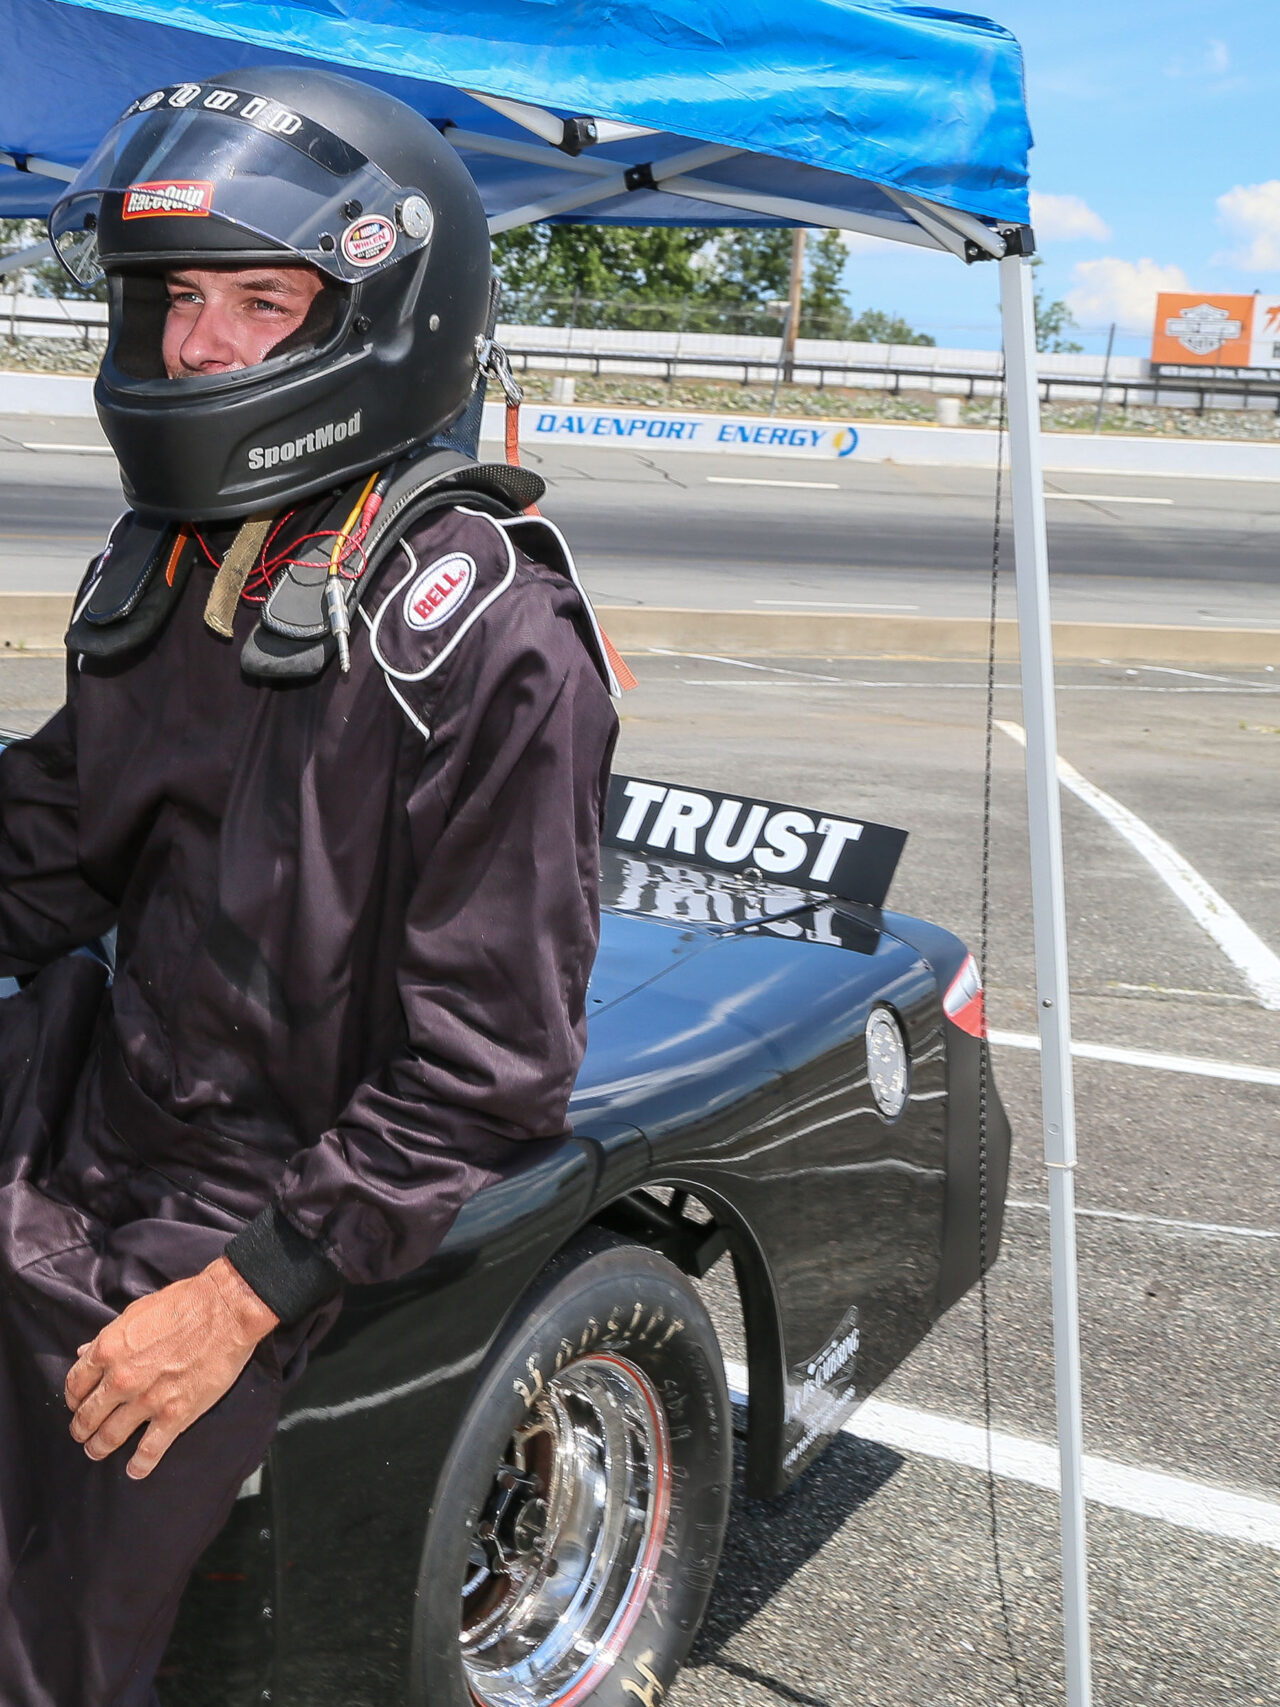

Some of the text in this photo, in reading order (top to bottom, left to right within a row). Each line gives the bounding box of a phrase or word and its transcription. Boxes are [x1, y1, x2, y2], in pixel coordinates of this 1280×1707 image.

[352, 231, 387, 251] WHELEN
[248, 410, 362, 470] SportMod
[535, 413, 826, 447] DAVENPORT ENERGY
[413, 572, 464, 620] BELL
[616, 780, 865, 883] TRUST
